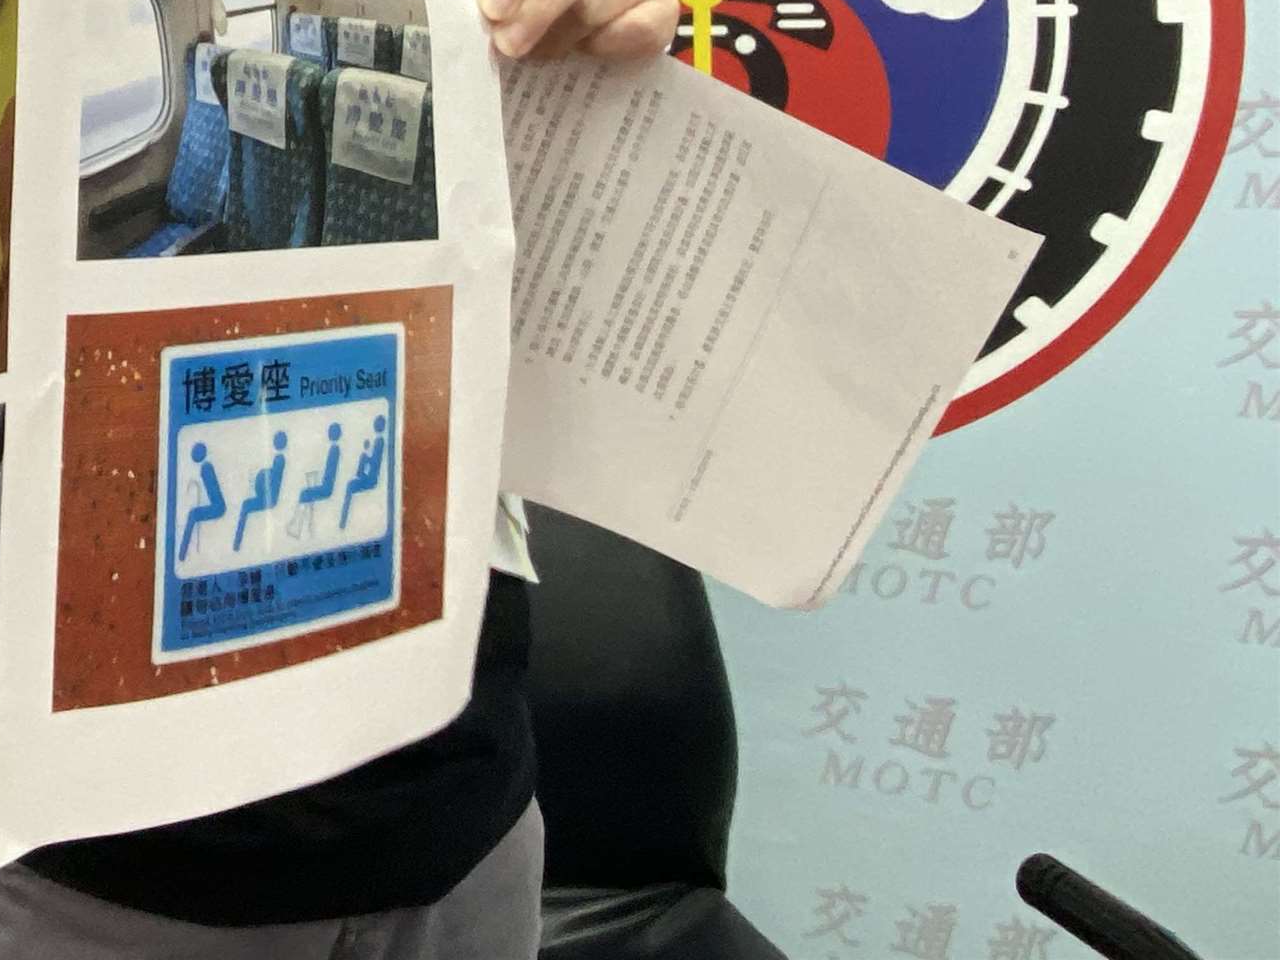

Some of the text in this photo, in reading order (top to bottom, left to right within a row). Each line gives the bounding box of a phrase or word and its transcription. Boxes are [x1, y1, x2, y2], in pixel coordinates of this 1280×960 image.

[182, 359, 388, 415] 博愛座 Priority Seat
[800, 680, 1058, 771] 交通部
[821, 748, 997, 812] MOTC
